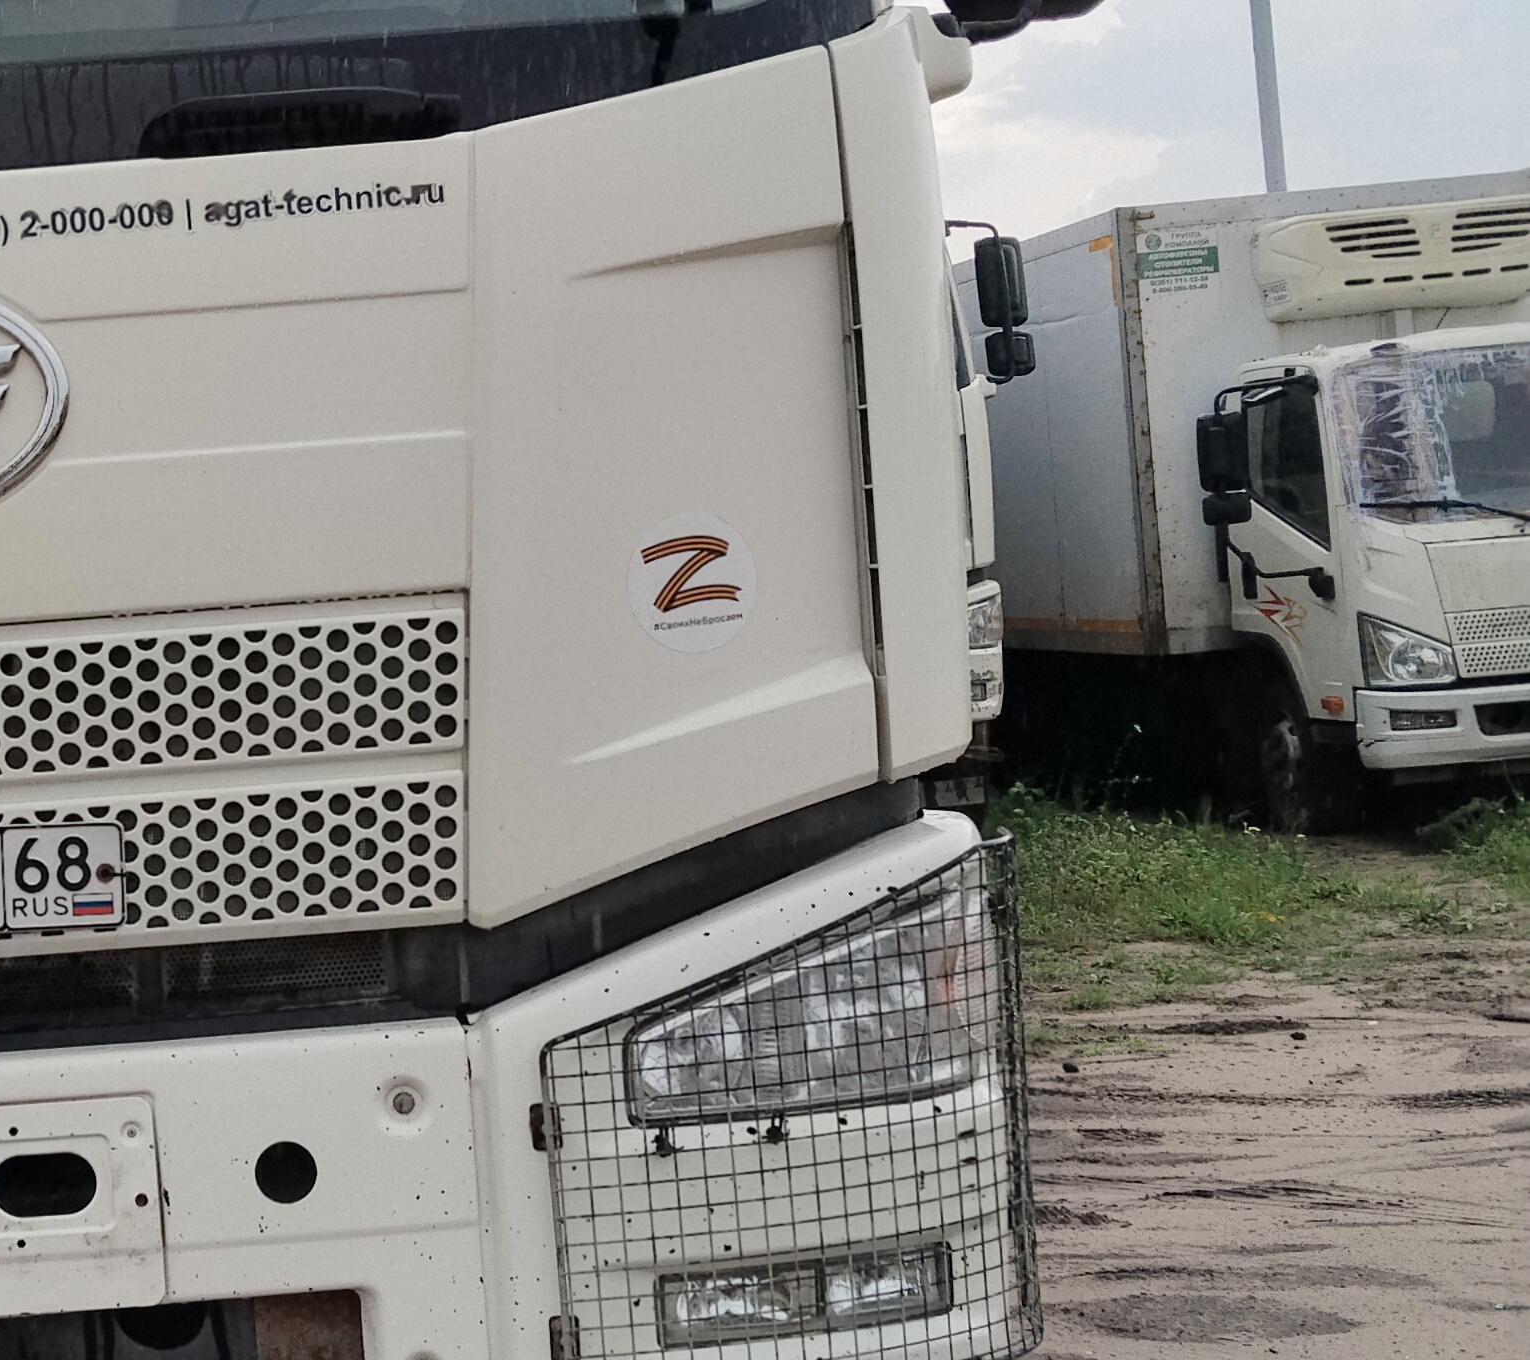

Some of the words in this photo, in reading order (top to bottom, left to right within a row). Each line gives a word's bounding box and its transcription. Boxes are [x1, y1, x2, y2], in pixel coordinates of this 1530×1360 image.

[203, 181, 446, 228] agat-technic.ru
[1164, 237, 1210, 249] КОМПАНИЙ
[1171, 231, 1202, 240] ГРУППА
[641, 535, 742, 613] Z
[653, 612, 744, 631] #СвоихНеБросаем
[13, 834, 92, 894] 68
[11, 894, 69, 918] RUS
